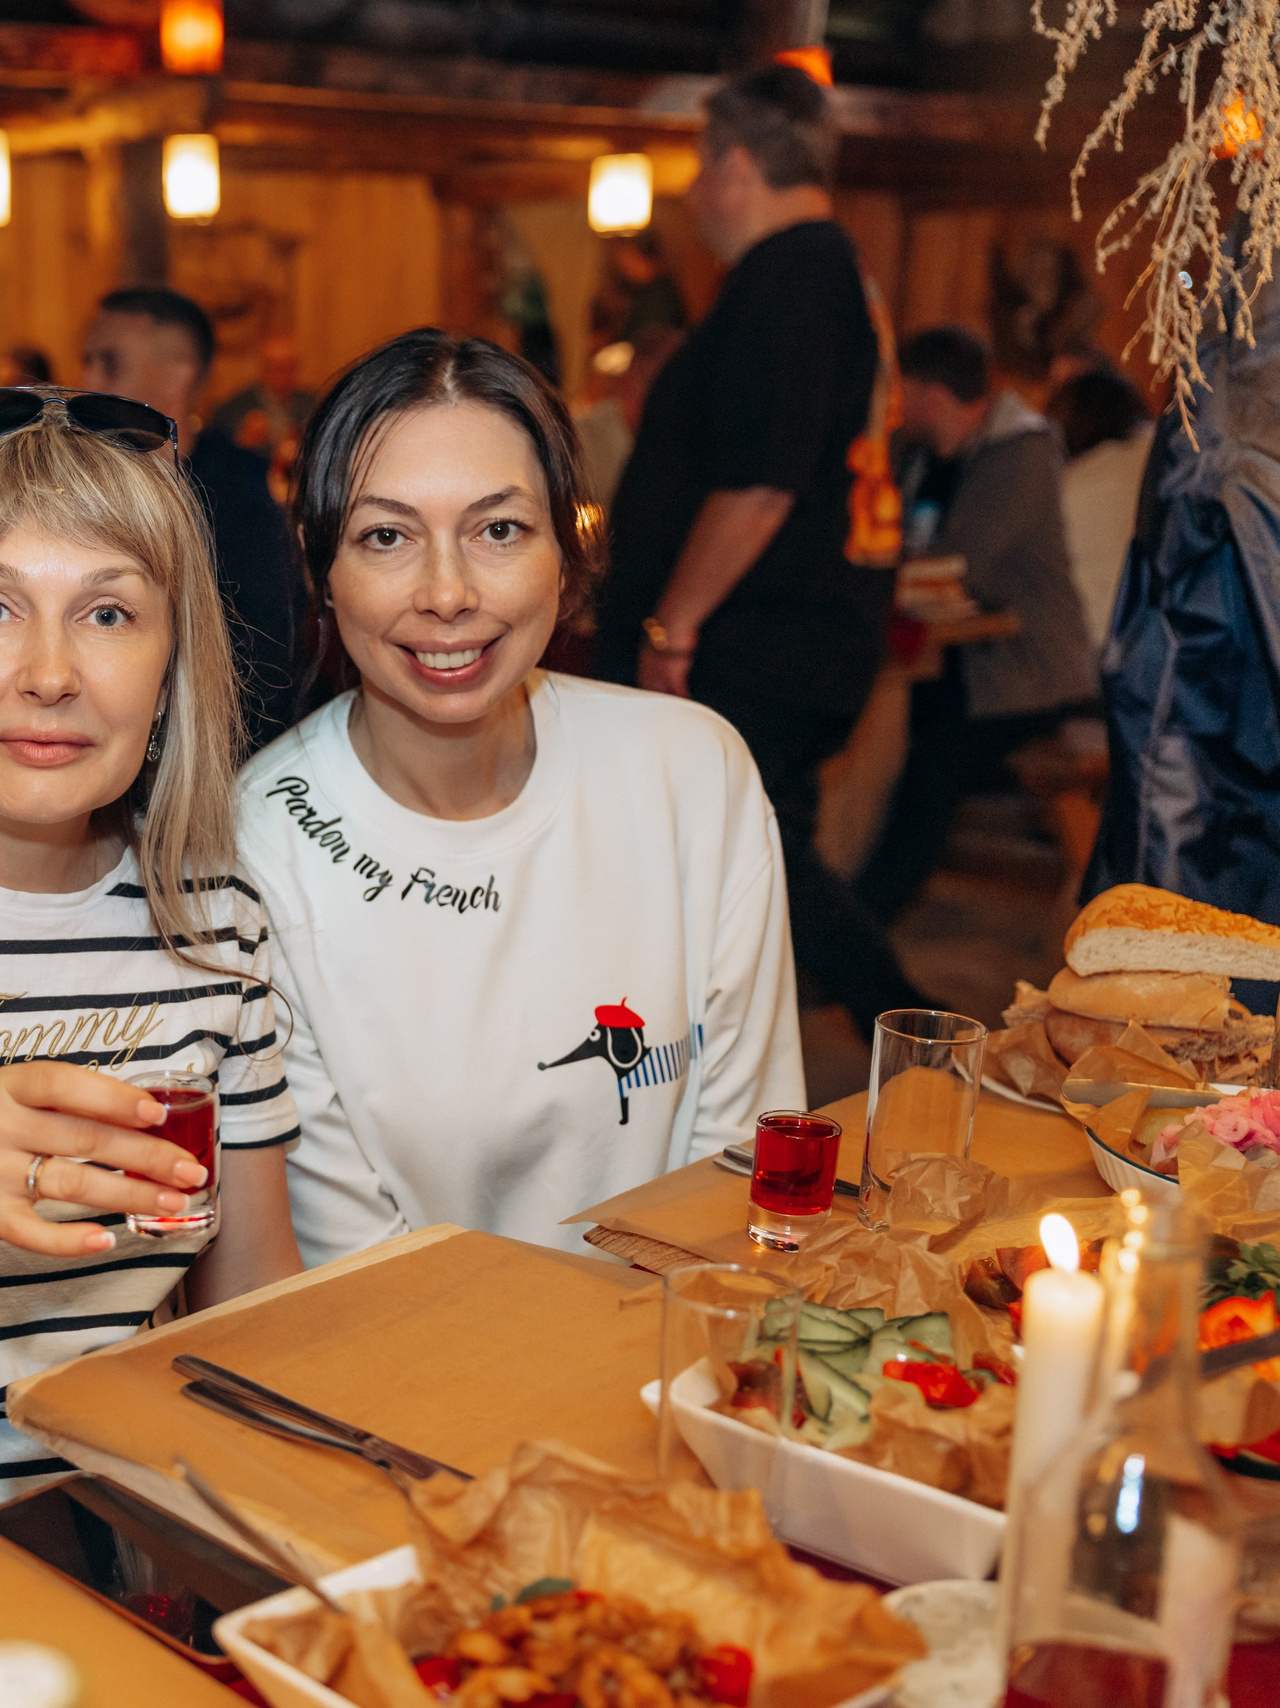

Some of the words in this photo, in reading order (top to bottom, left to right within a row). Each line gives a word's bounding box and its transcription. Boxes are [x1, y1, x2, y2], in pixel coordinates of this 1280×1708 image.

[266, 776, 351, 863] Pardon
[353, 854, 393, 902] my
[401, 867, 501, 914] French
